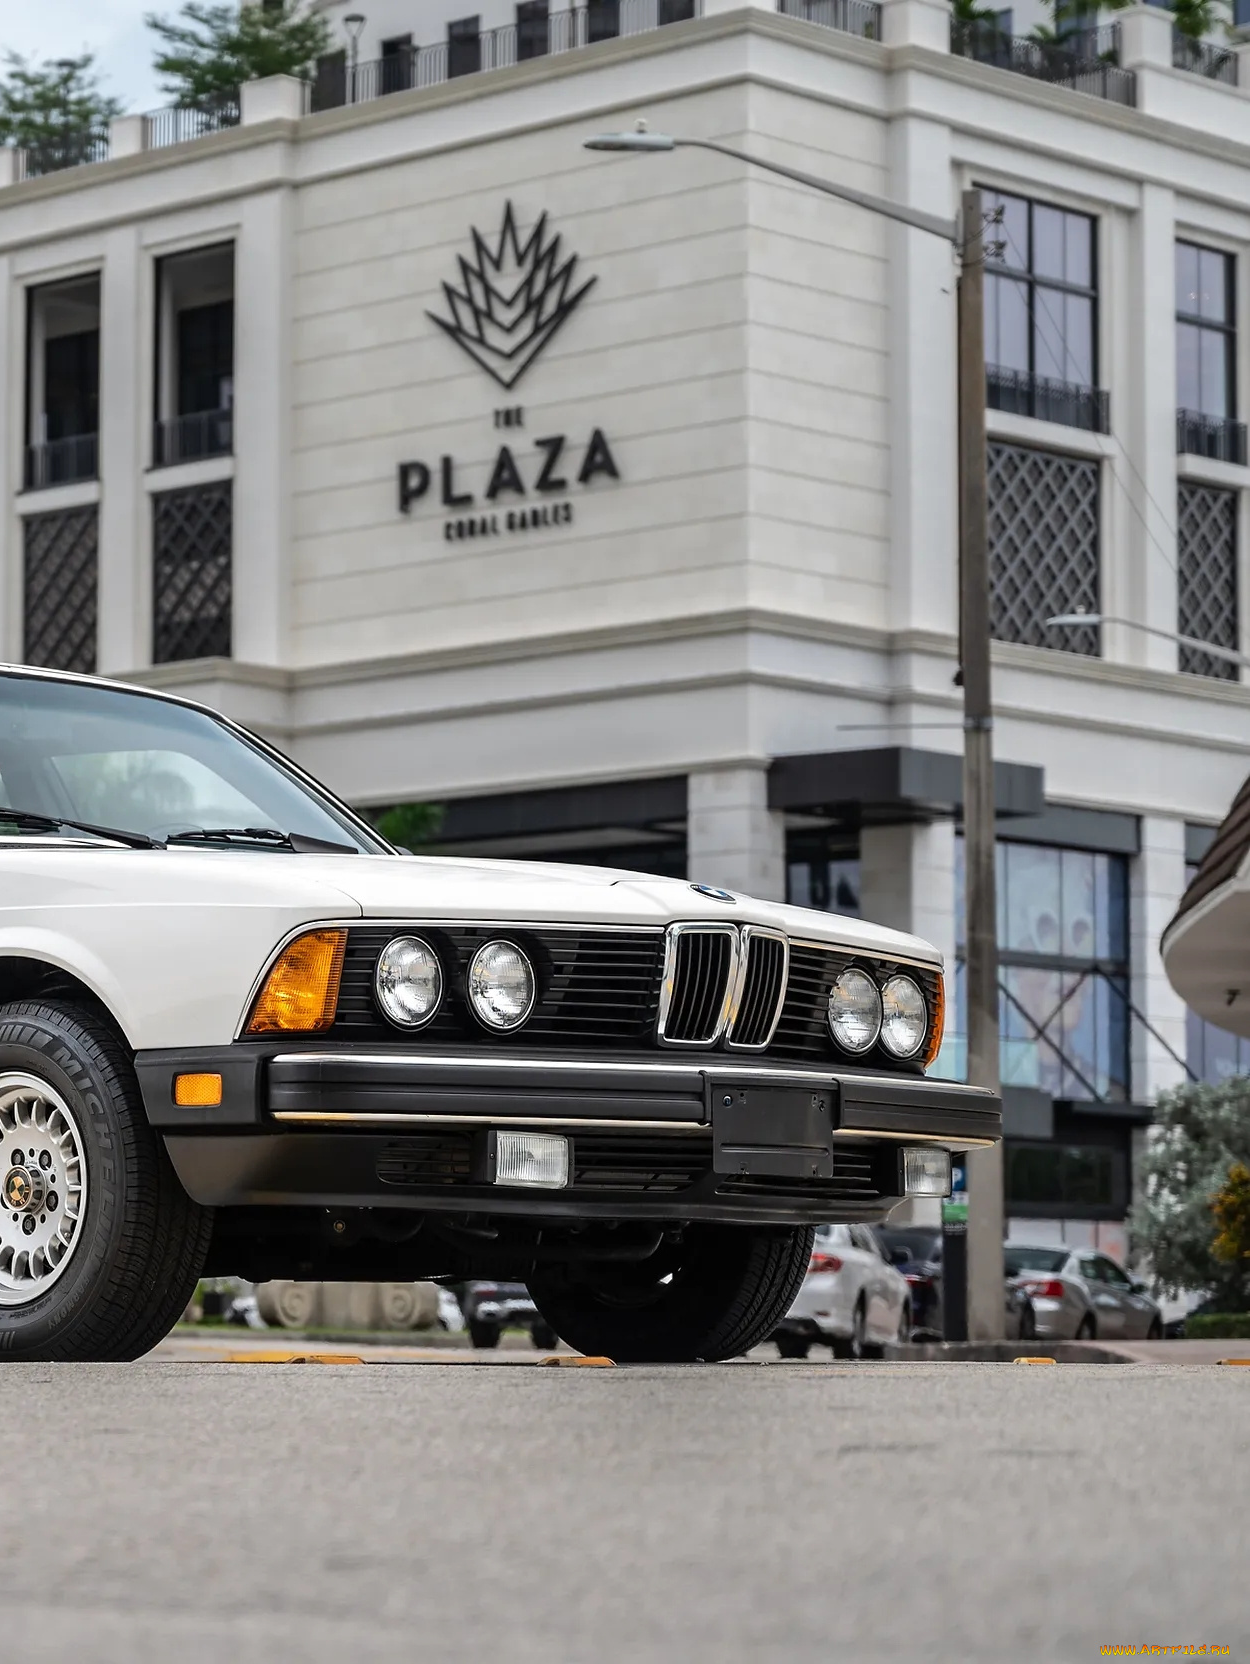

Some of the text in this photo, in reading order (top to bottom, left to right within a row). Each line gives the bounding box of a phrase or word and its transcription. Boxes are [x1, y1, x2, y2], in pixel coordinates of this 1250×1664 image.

[494, 406, 524, 430] THE
[398, 427, 619, 514] PLAZA
[445, 502, 572, 541] CORAL GABLES
[51, 1046, 117, 1261] MICHELIN
[48, 1274, 90, 1330] HARMONY
